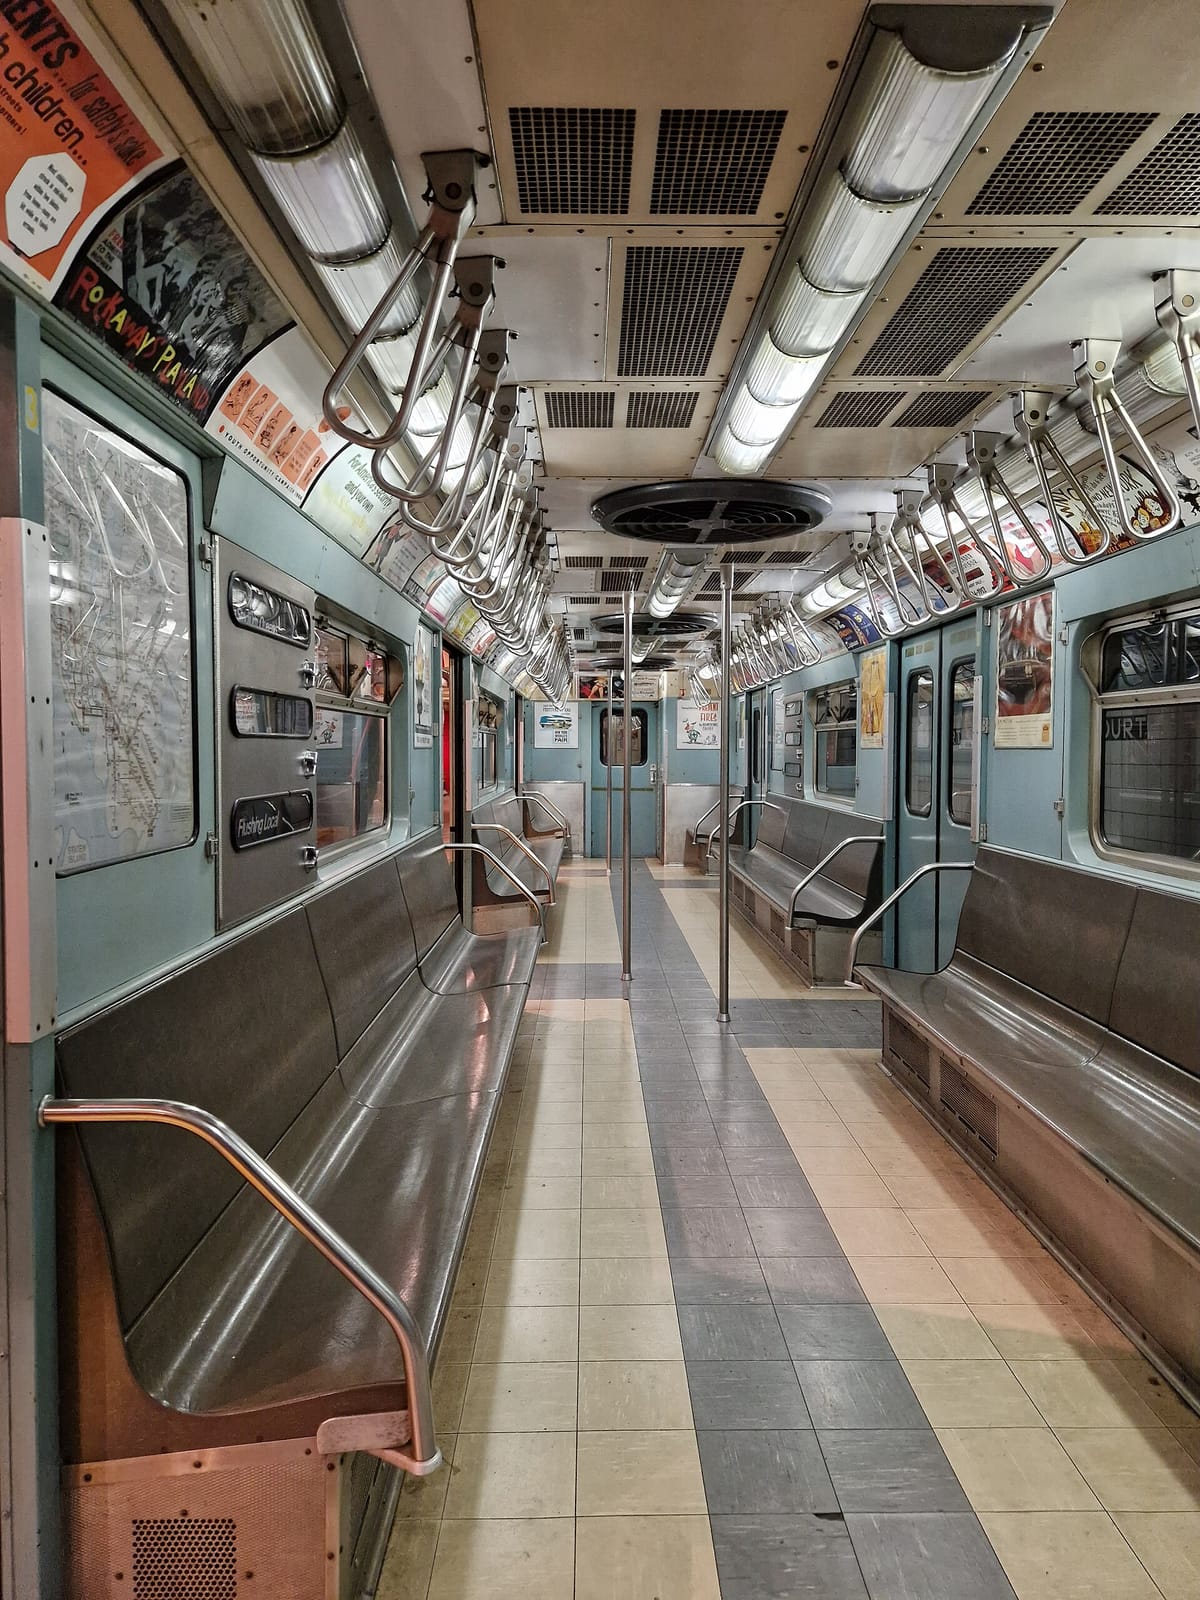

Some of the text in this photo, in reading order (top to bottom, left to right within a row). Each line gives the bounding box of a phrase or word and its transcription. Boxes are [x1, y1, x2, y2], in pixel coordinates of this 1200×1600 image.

[0, 85, 22, 113] treets
[0, 104, 26, 136] orners!
[223, 431, 243, 450] YOUTH
[237, 810, 280, 838] Flushing Local
